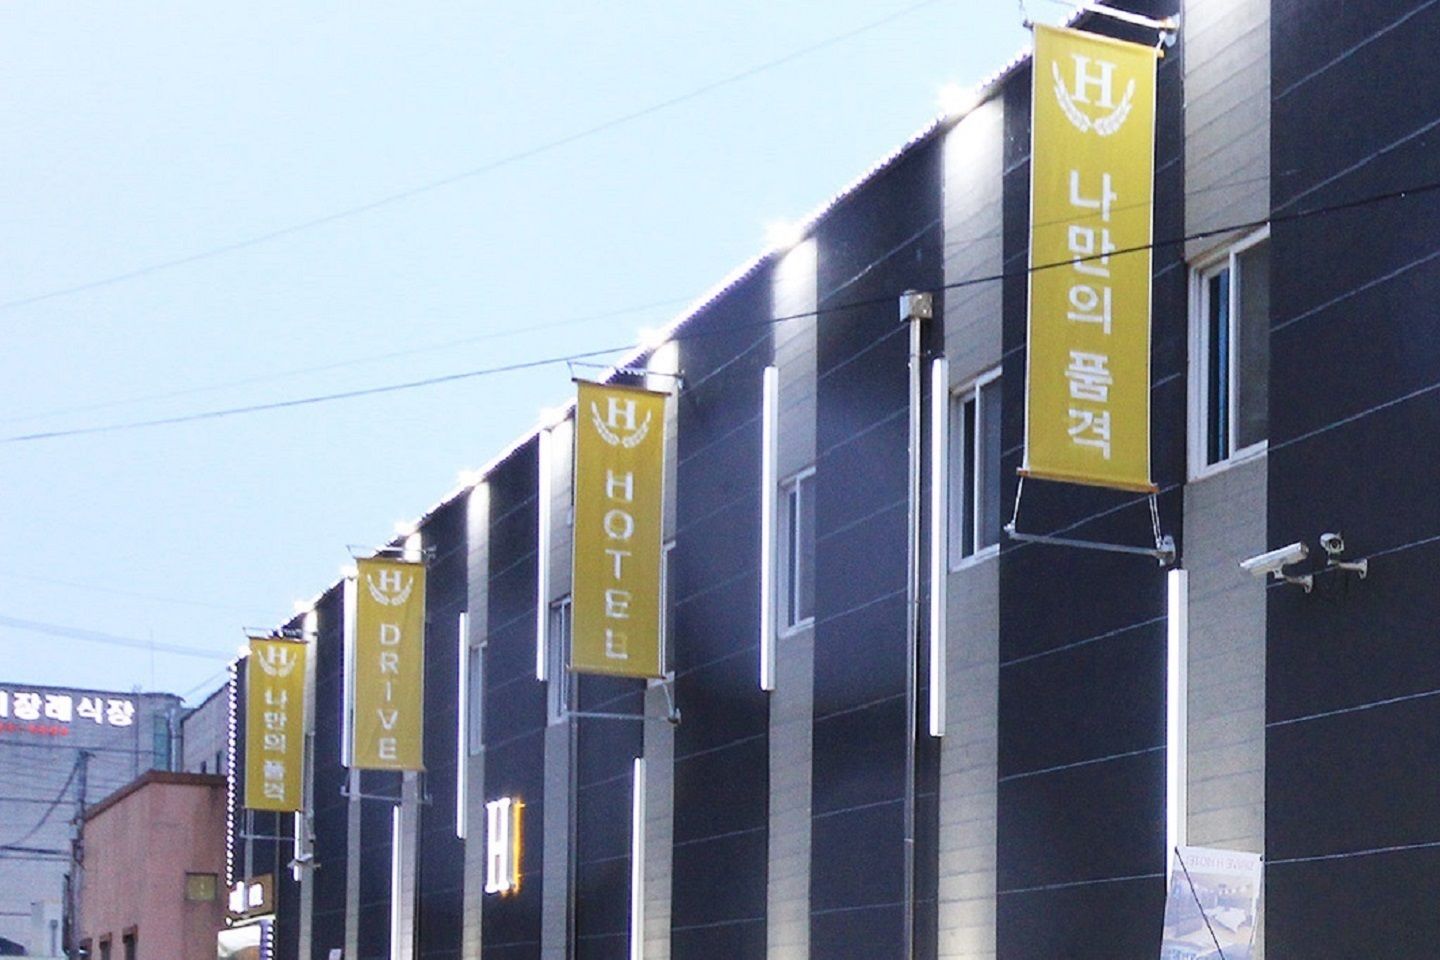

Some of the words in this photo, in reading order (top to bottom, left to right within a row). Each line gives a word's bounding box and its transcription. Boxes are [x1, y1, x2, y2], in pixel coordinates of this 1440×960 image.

[1070, 53, 1117, 109] H
[1068, 170, 1117, 334] 나만의
[606, 397, 636, 430] H
[1064, 349, 1112, 460] 품격
[378, 569, 402, 592] H
[603, 469, 635, 660] HOTEL
[377, 623, 401, 760] DRIVE
[485, 797, 518, 894] H
